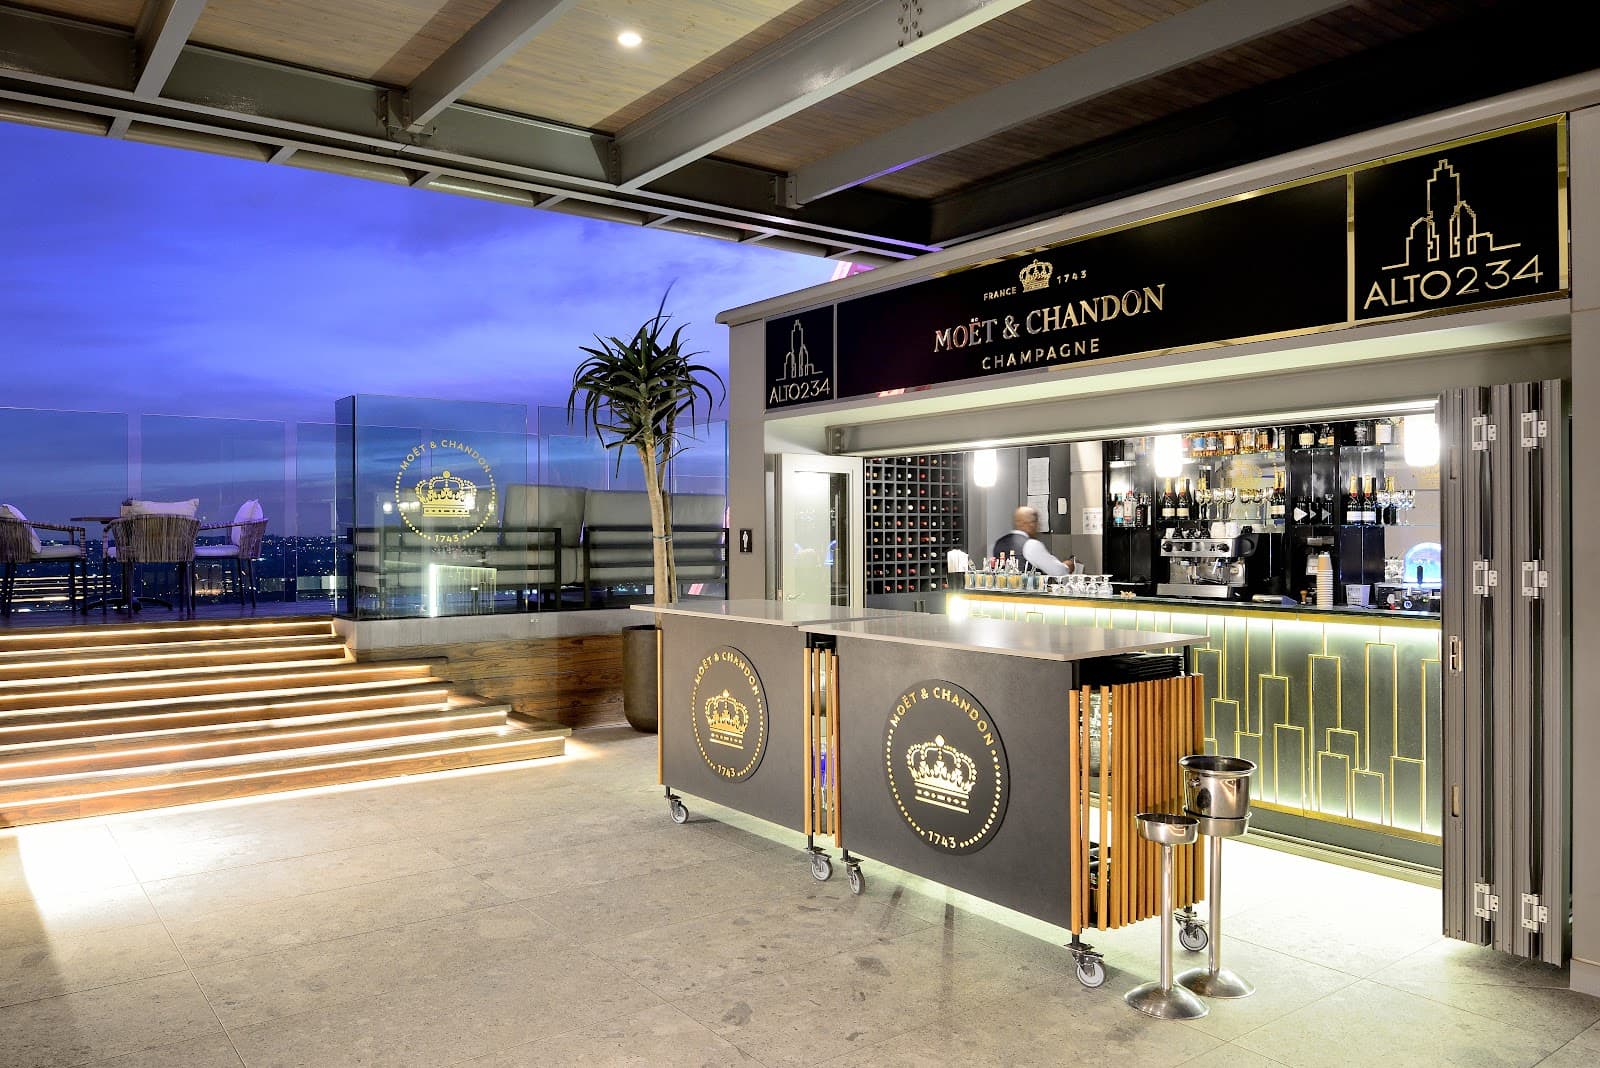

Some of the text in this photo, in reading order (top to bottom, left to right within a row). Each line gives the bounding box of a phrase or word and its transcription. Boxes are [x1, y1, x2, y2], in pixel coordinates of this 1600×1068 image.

[1057, 269, 1087, 285] 1743
[1363, 254, 1543, 309] ALTO234
[983, 286, 1017, 301] FRANCE
[933, 283, 1166, 352] MOËT & CHANDON
[981, 338, 1100, 370] CHAMPAGNE
[769, 377, 831, 404] ALTO234
[430, 441, 437, 449] &
[441, 439, 491, 474] CHANDON
[434, 534, 460, 543] 1743
[721, 651, 760, 696] CHANDON
[889, 686, 995, 746] MOËT & CHANDON
[717, 764, 736, 778] 1743
[927, 830, 957, 849] 1743
